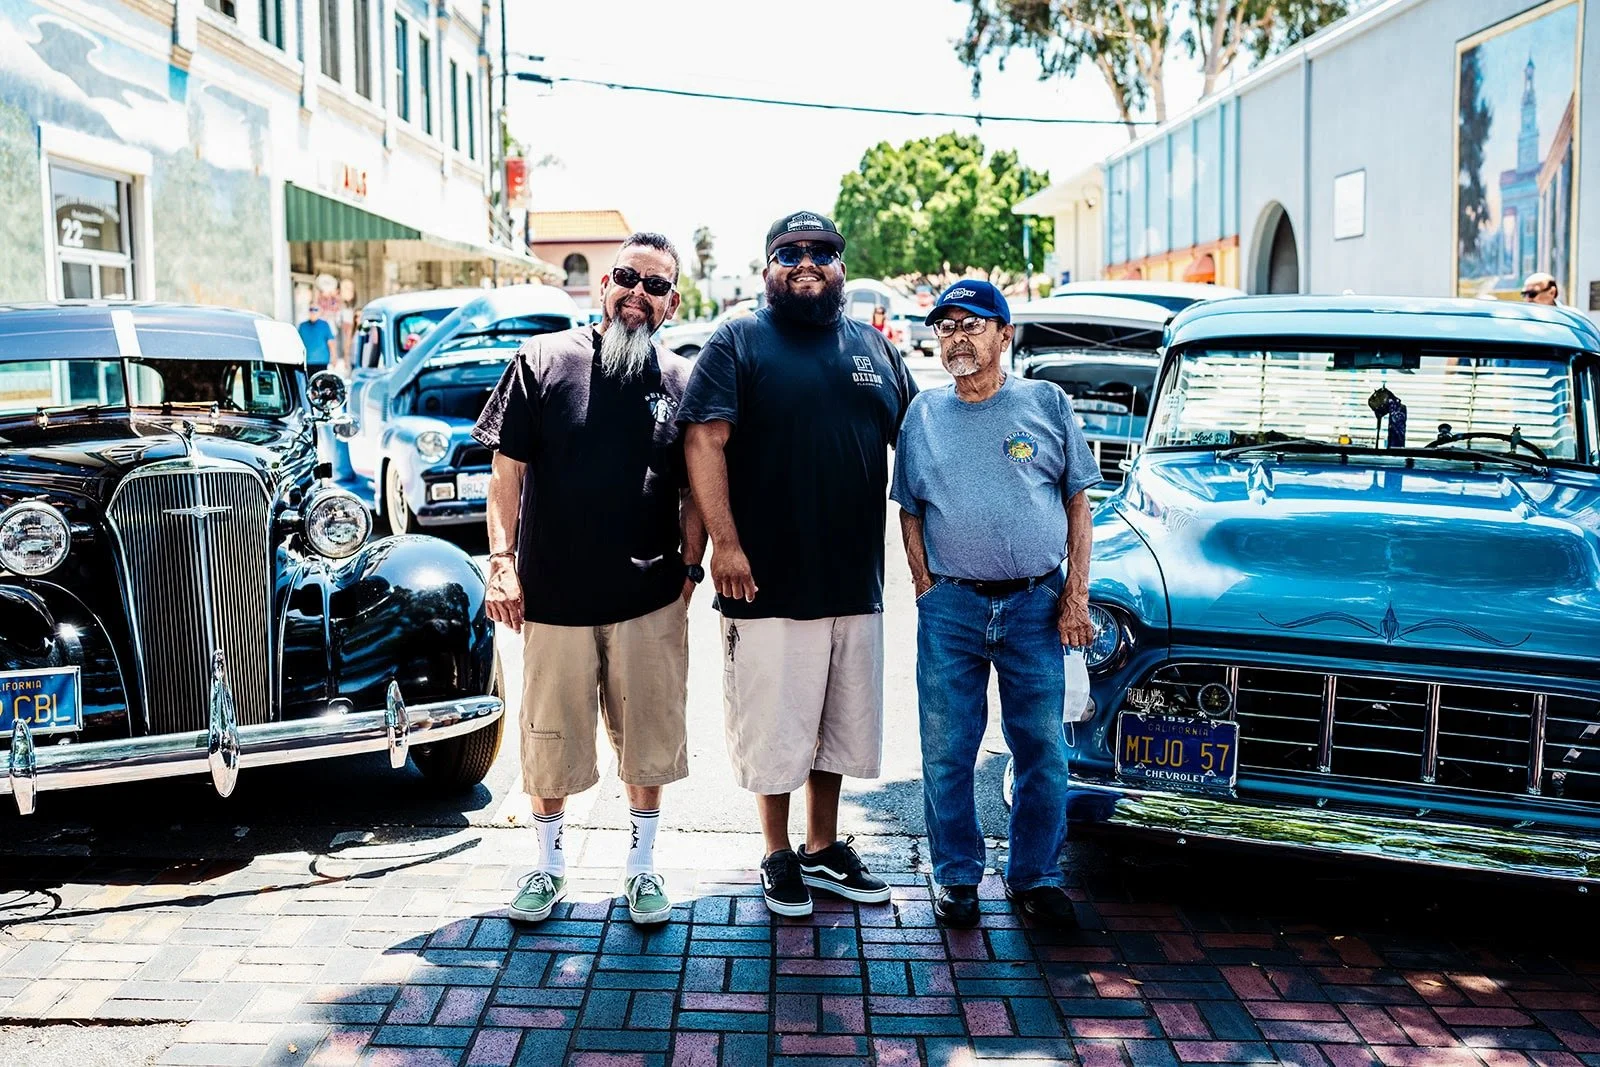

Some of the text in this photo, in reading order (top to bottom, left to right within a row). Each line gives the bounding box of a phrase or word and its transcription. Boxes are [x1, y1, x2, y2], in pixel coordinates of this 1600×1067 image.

[0, 680, 42, 691] IFORNIA
[14, 693, 71, 724] CBL
[1162, 715, 1195, 724] 1957
[1148, 723, 1209, 737] CALIFORNIA
[1126, 735, 1229, 771] MIJO 57
[1145, 769, 1206, 783] CHEVROLET
